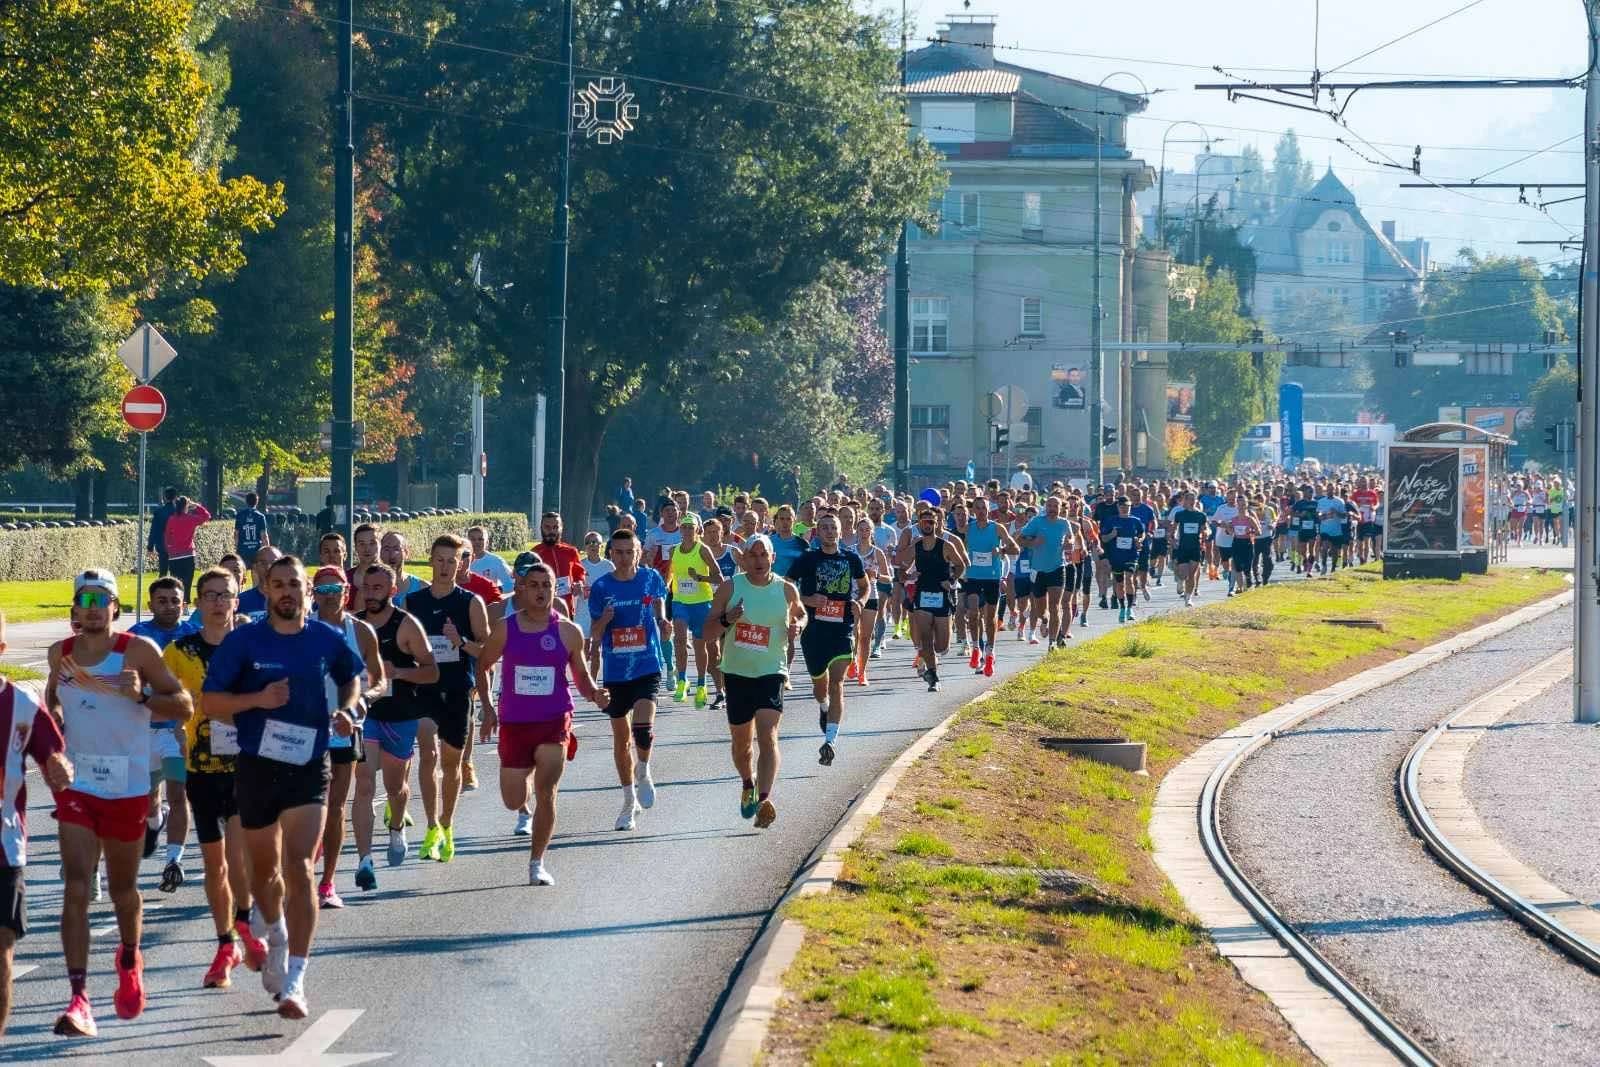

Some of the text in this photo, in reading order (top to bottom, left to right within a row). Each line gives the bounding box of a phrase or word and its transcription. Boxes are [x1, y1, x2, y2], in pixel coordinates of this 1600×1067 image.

[1396, 475, 1441, 491] Naše
[1392, 485, 1448, 512] mjesto
[742, 630, 764, 641] 5166
